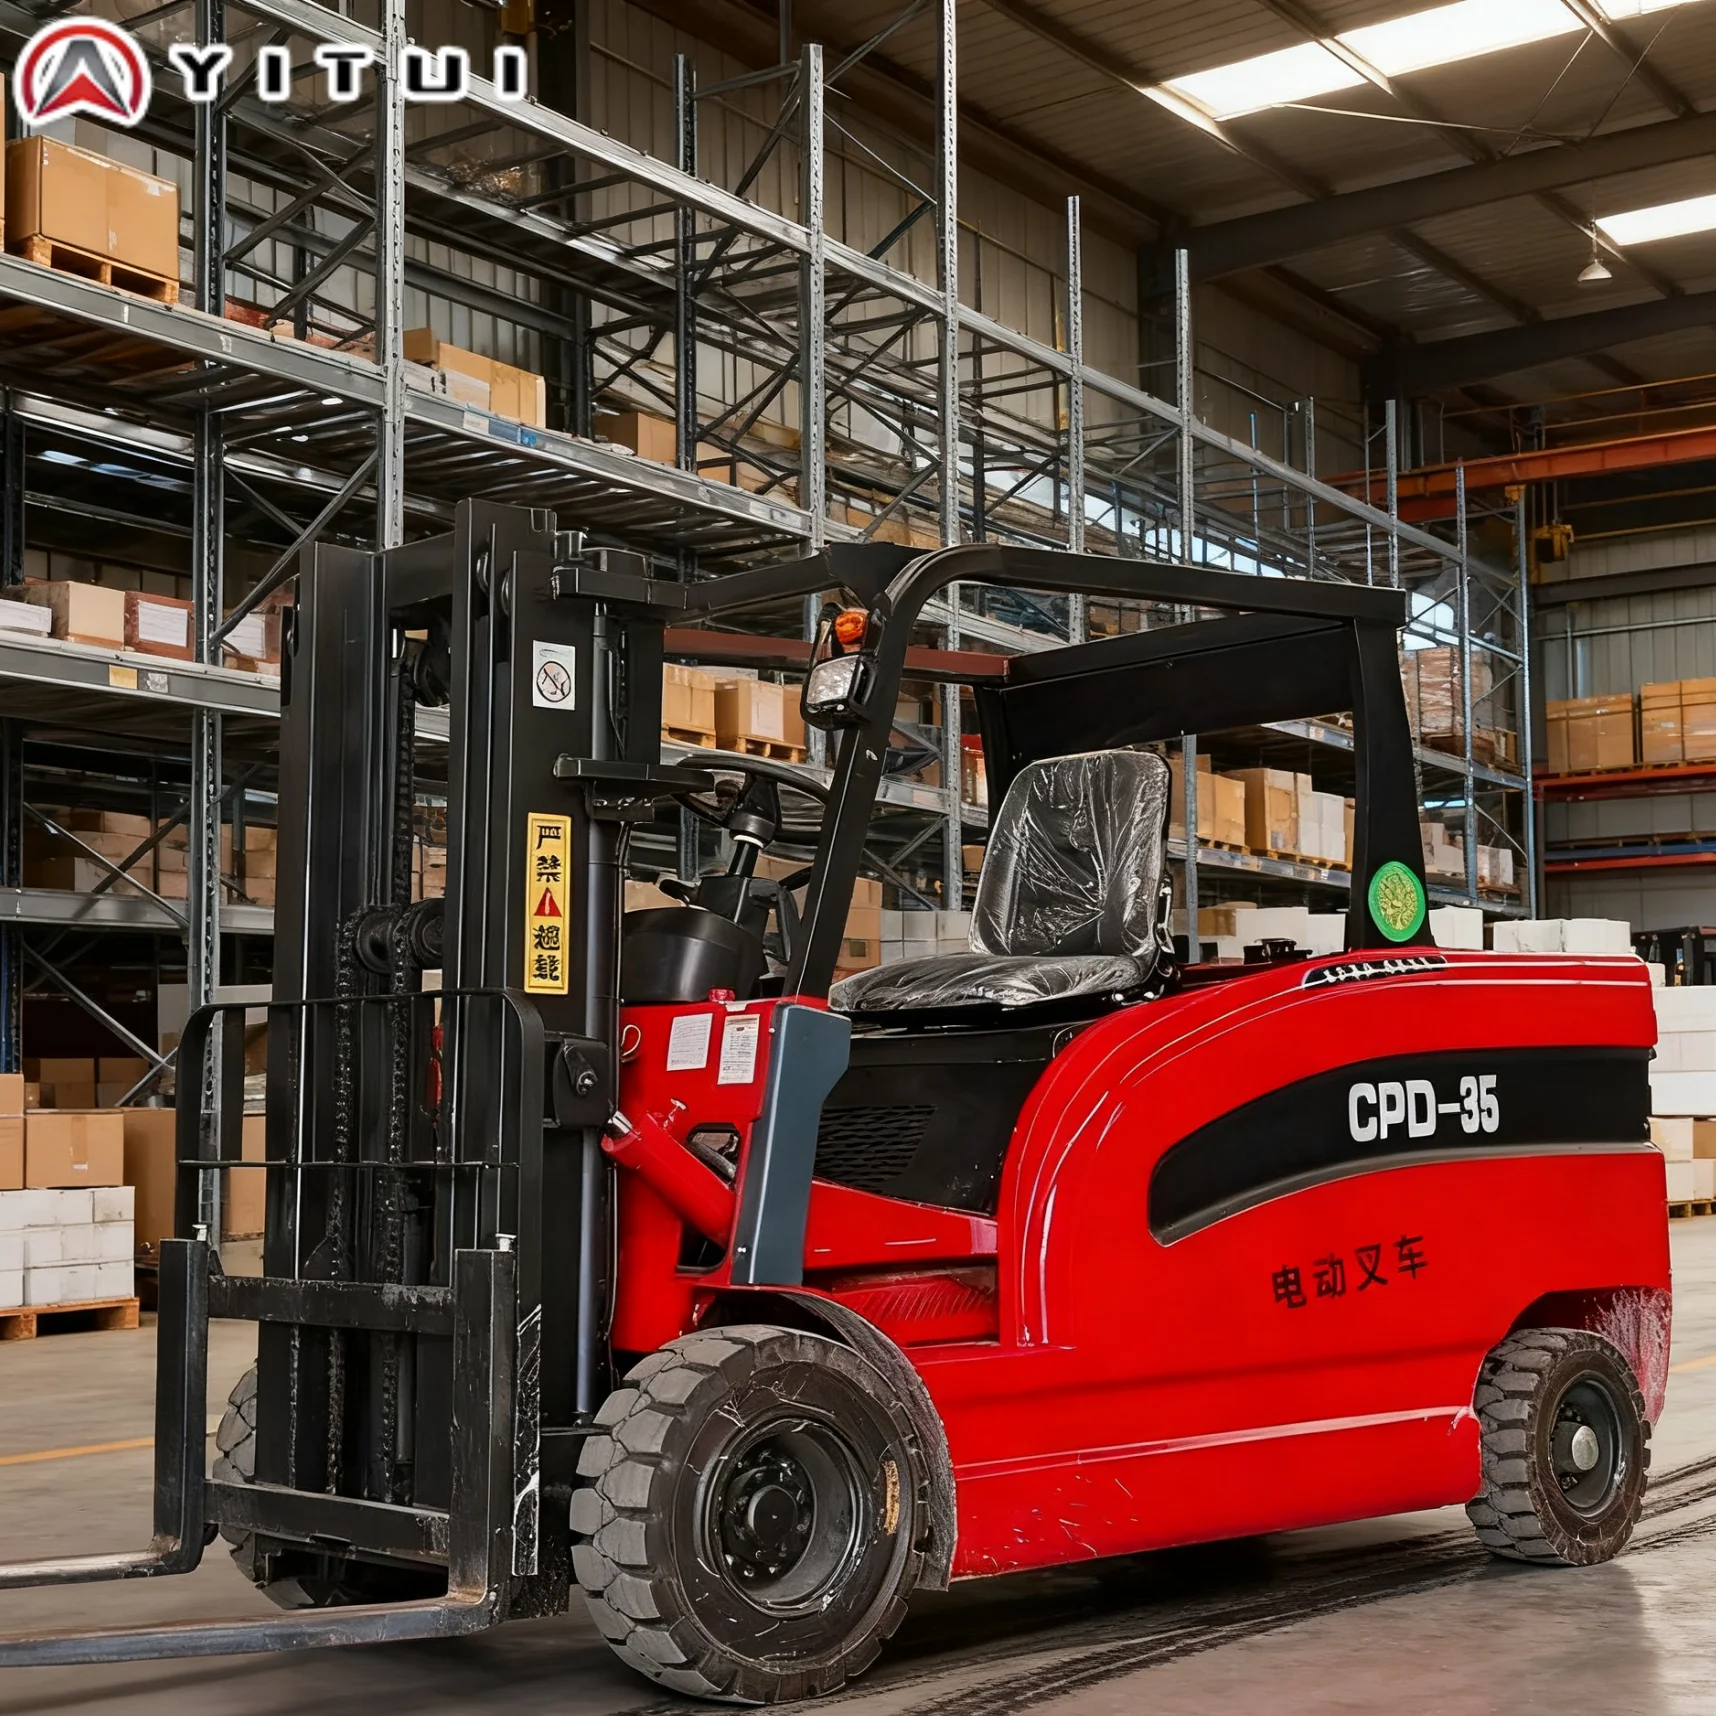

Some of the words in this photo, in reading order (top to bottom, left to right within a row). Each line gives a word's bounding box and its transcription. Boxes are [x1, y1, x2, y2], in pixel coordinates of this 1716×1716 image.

[1348, 1074, 1500, 1142] CPD-35
[1272, 1233, 1428, 1309] 电动叉车
